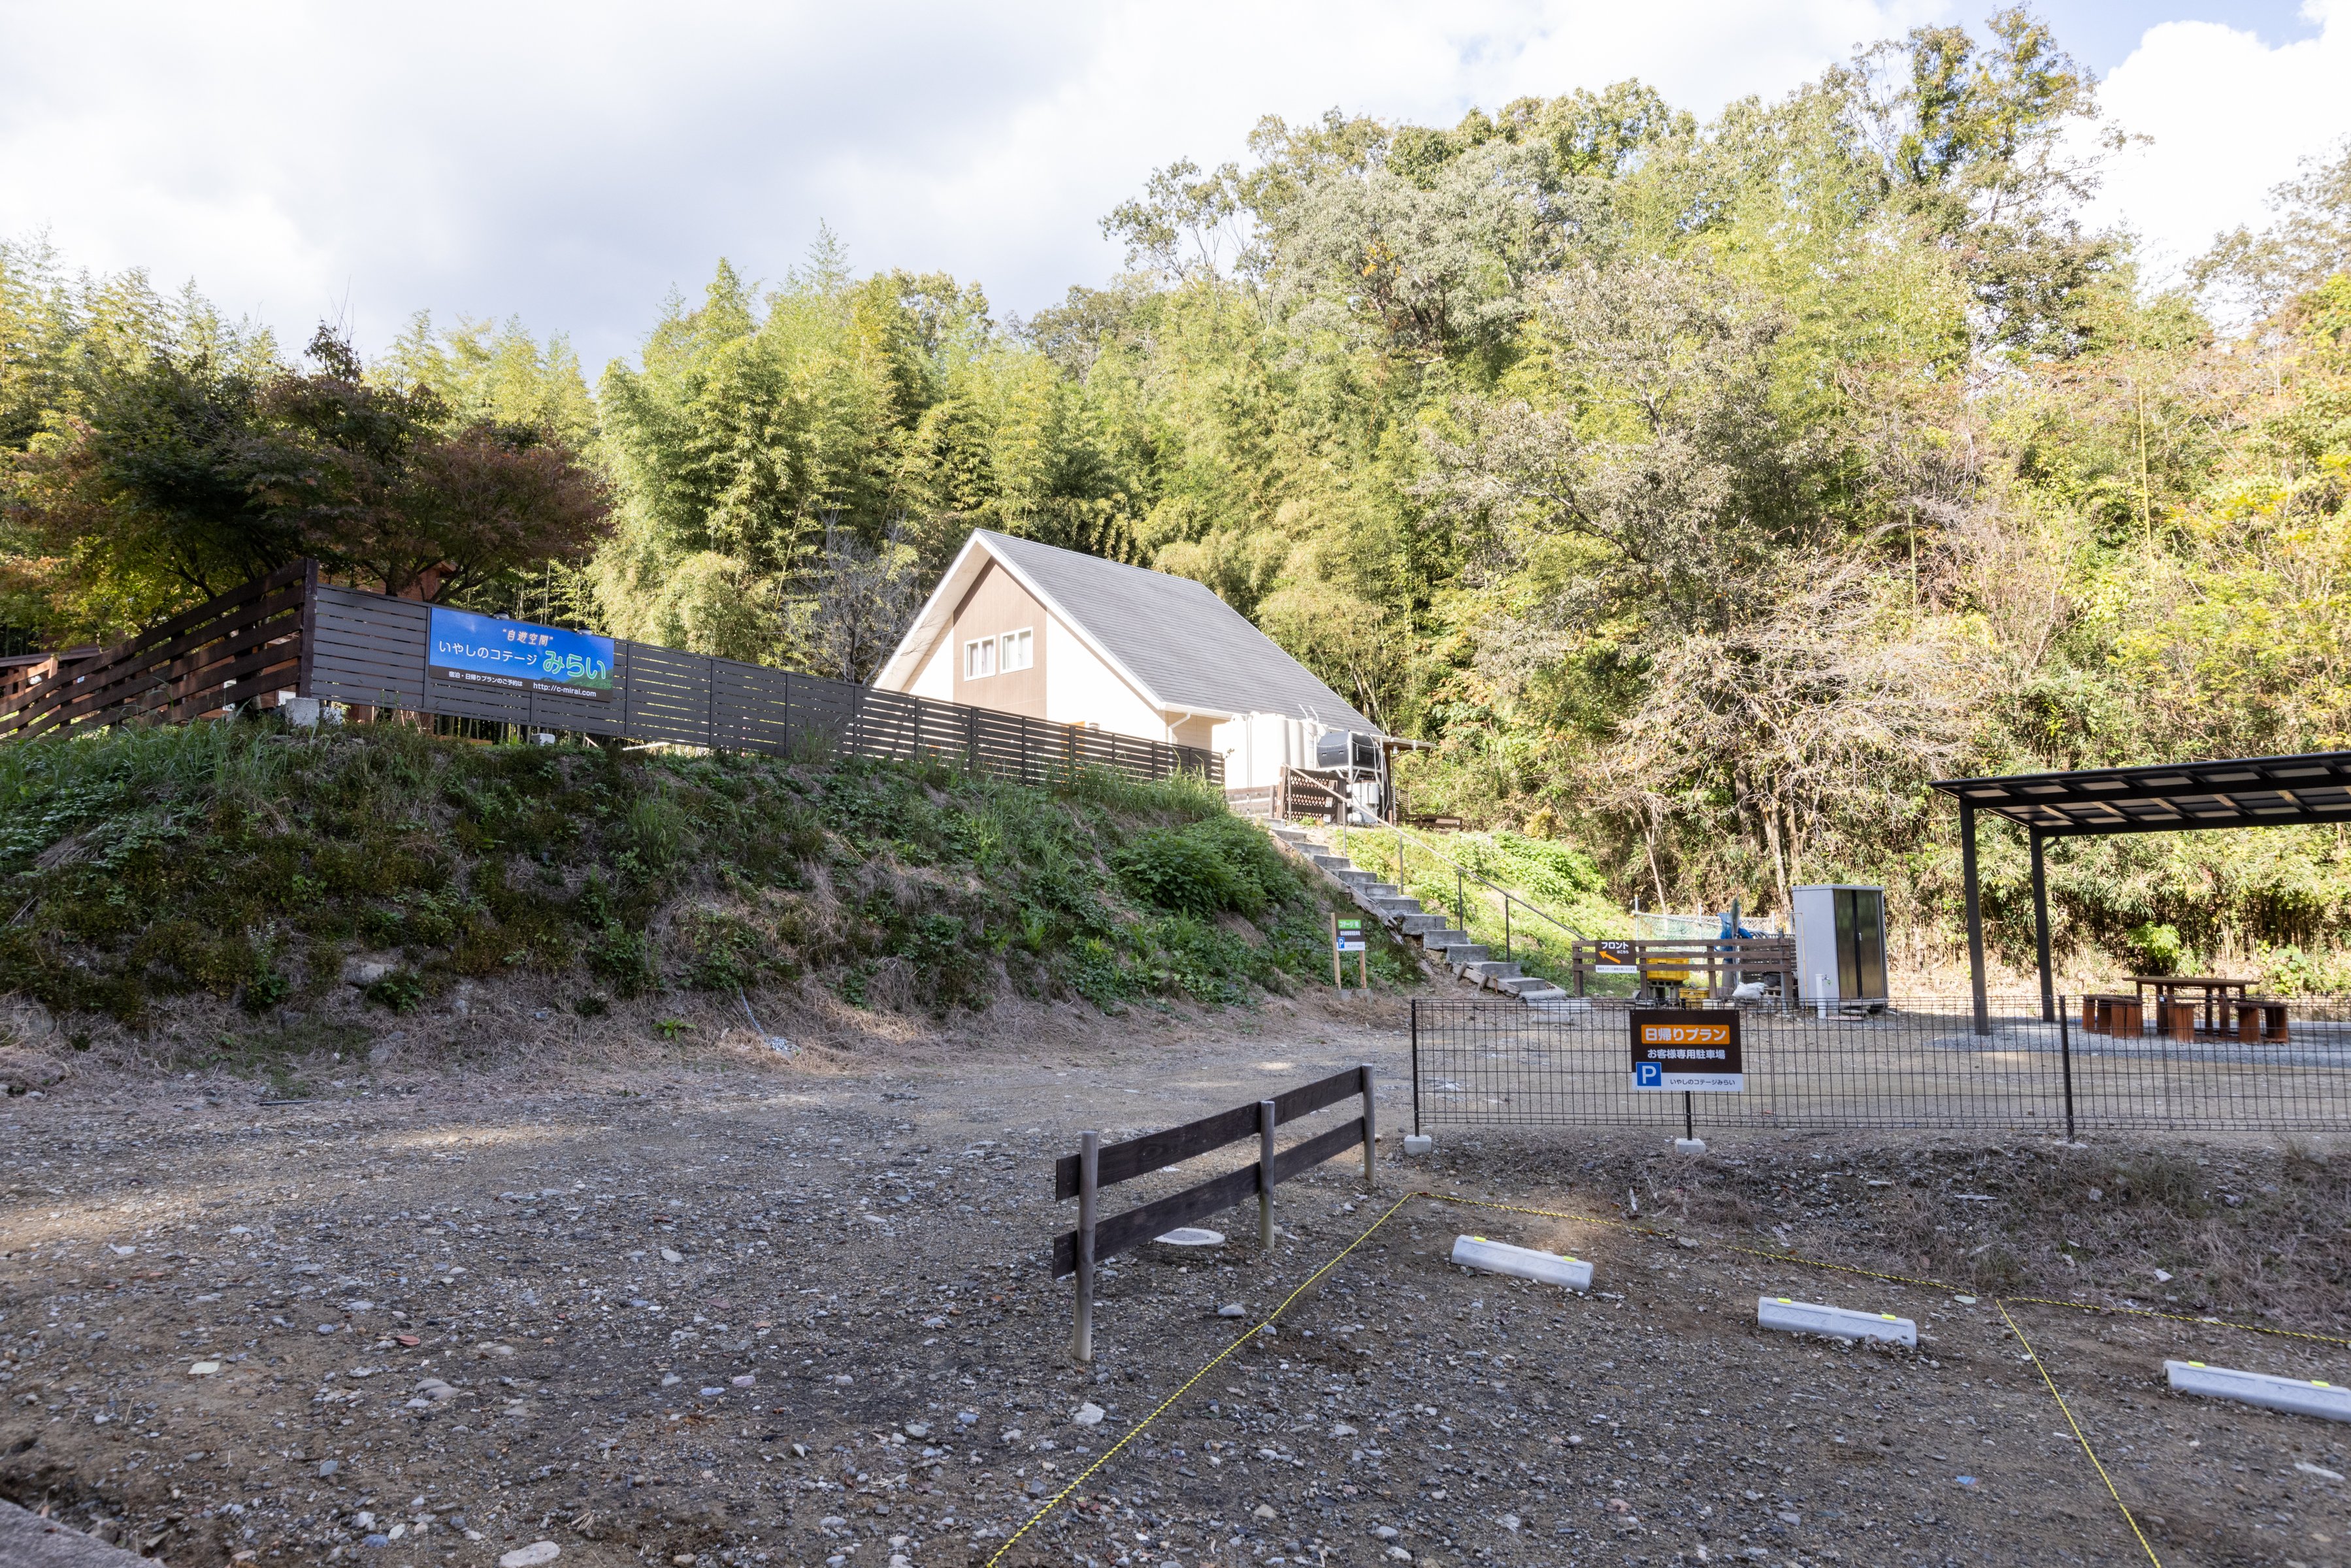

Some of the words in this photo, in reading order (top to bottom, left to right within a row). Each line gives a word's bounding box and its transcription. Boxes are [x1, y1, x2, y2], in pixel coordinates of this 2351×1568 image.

[438, 640, 537, 666] いやしのコテージ
[542, 650, 606, 679] みらい
[448, 671, 523, 687] 宿泊・日帰りプランのご予約は
[533, 681, 597, 697] http://c-mirai.com
[1339, 939, 1343, 948] P
[1645, 1028, 1726, 1041] 日帰りプラン
[1647, 1049, 1726, 1060] お客様専用駐車場
[1642, 1065, 1656, 1084] P
